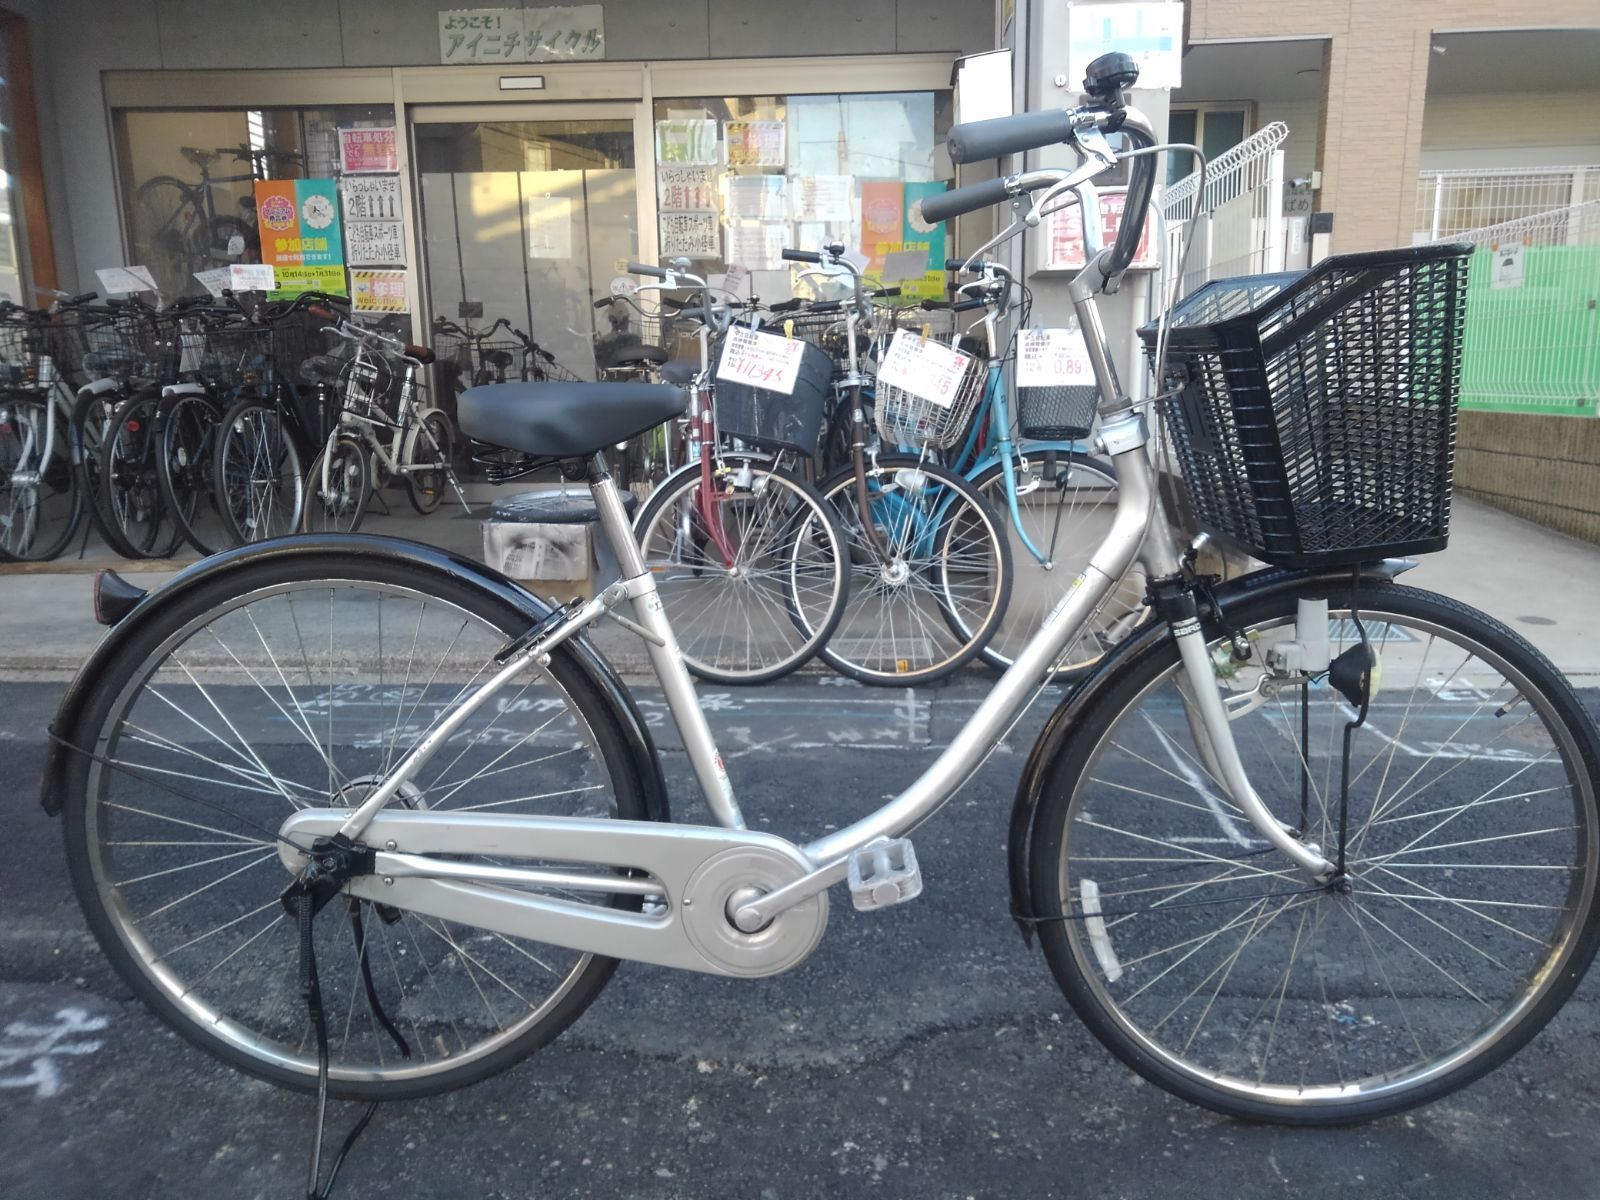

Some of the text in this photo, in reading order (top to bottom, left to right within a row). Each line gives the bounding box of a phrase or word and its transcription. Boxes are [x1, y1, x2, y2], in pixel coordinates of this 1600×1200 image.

[445, 28, 601, 58] アイニチサイクル
[274, 237, 328, 252] 参加店舗
[372, 281, 404, 297] 修理
